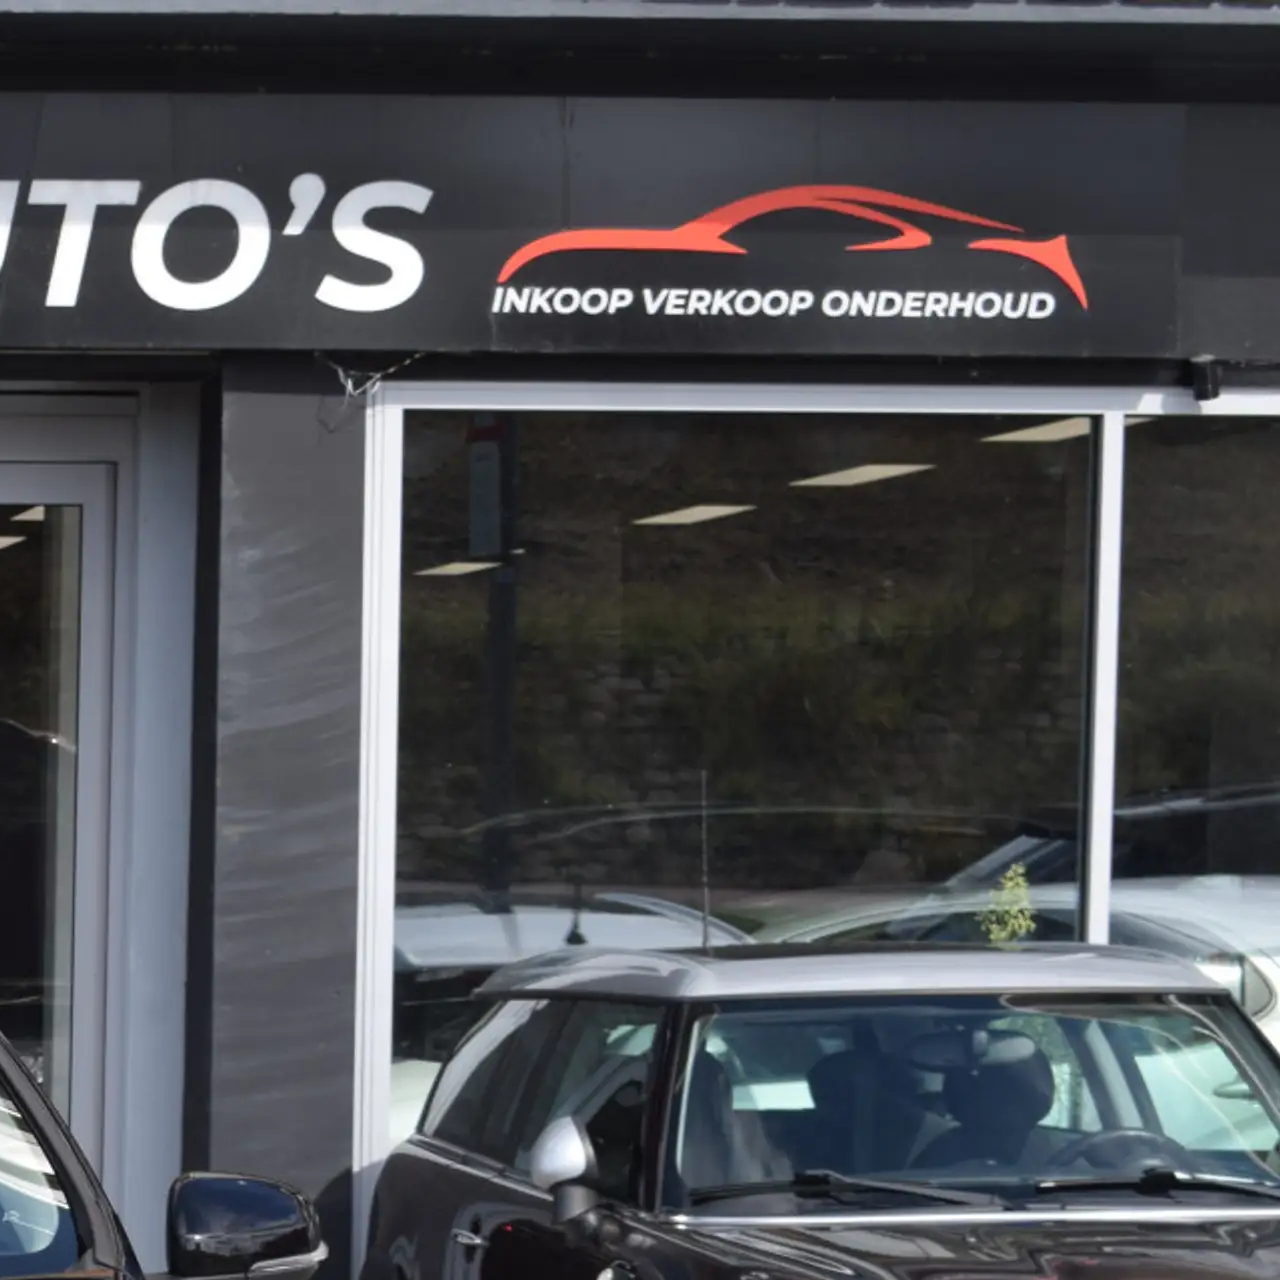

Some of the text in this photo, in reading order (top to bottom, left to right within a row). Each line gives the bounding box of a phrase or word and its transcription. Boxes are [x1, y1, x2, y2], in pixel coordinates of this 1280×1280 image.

[491, 286, 1056, 319] INKOOP VERKOOP ONDERHOUD
